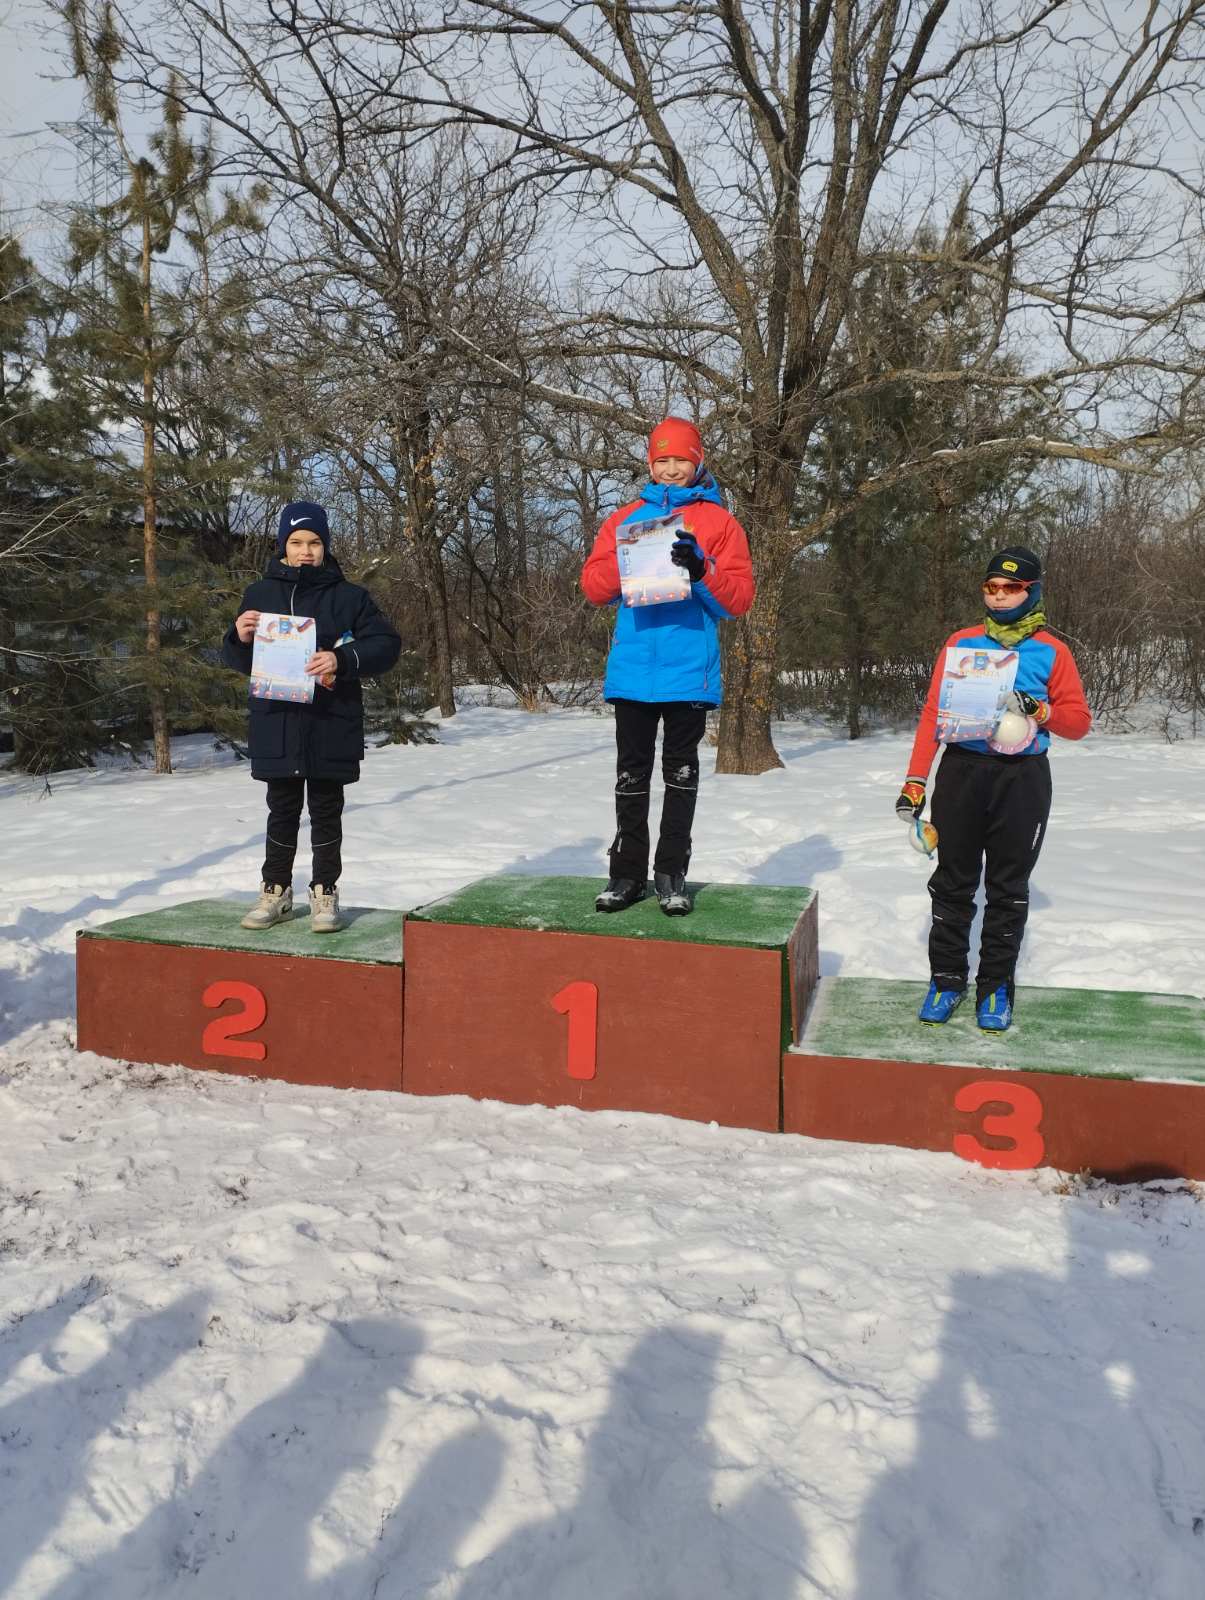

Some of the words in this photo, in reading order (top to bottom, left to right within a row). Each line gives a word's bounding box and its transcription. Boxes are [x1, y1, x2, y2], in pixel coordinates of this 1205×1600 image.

[202, 981, 267, 1061] 2
[550, 981, 598, 1080] 1
[953, 1081, 1044, 1170] 3
